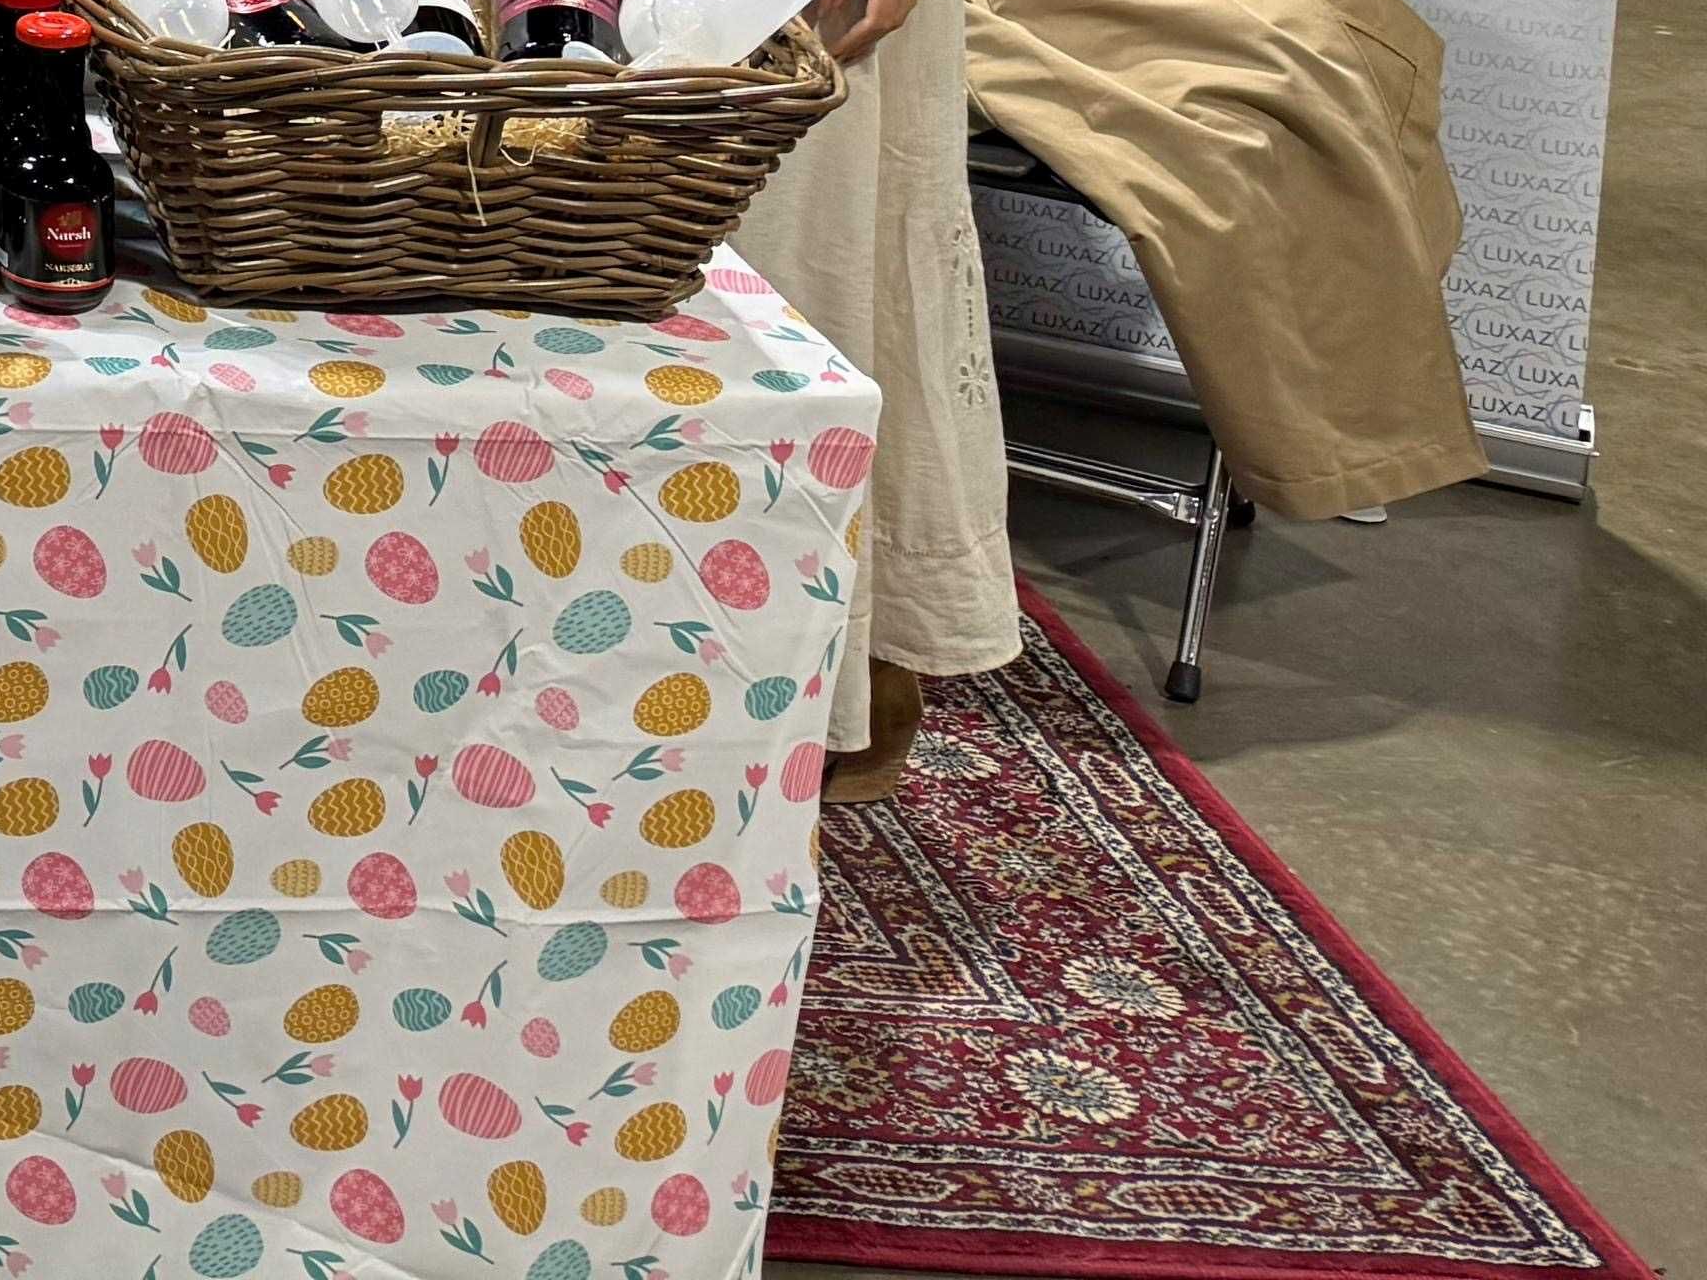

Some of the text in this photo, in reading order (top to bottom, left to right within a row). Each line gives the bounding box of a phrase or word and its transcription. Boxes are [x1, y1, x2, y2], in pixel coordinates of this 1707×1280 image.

[1455, 49, 1534, 74] LUXAZ
[1499, 92, 1577, 118] LUXAZ
[1448, 124, 1600, 158] LUXAZ LUXA
[1491, 169, 1569, 195] LUXAZ
[999, 198, 1068, 222] LUXAZ
[47, 227, 91, 241] Narsh
[1534, 214, 1594, 235] LUXA
[1038, 241, 1109, 265] LUXAZ
[1484, 245, 1561, 271] LUXAZ
[994, 268, 1148, 310] LUXAZ LUXAZ
[1447, 277, 1587, 313] UXAZ LUXA
[1032, 313, 1171, 348] LUXAZ LUXA
[1476, 319, 1555, 346] LUXAZ
[1519, 365, 1580, 389] LUXA
[1468, 394, 1547, 422] LUXAZ
